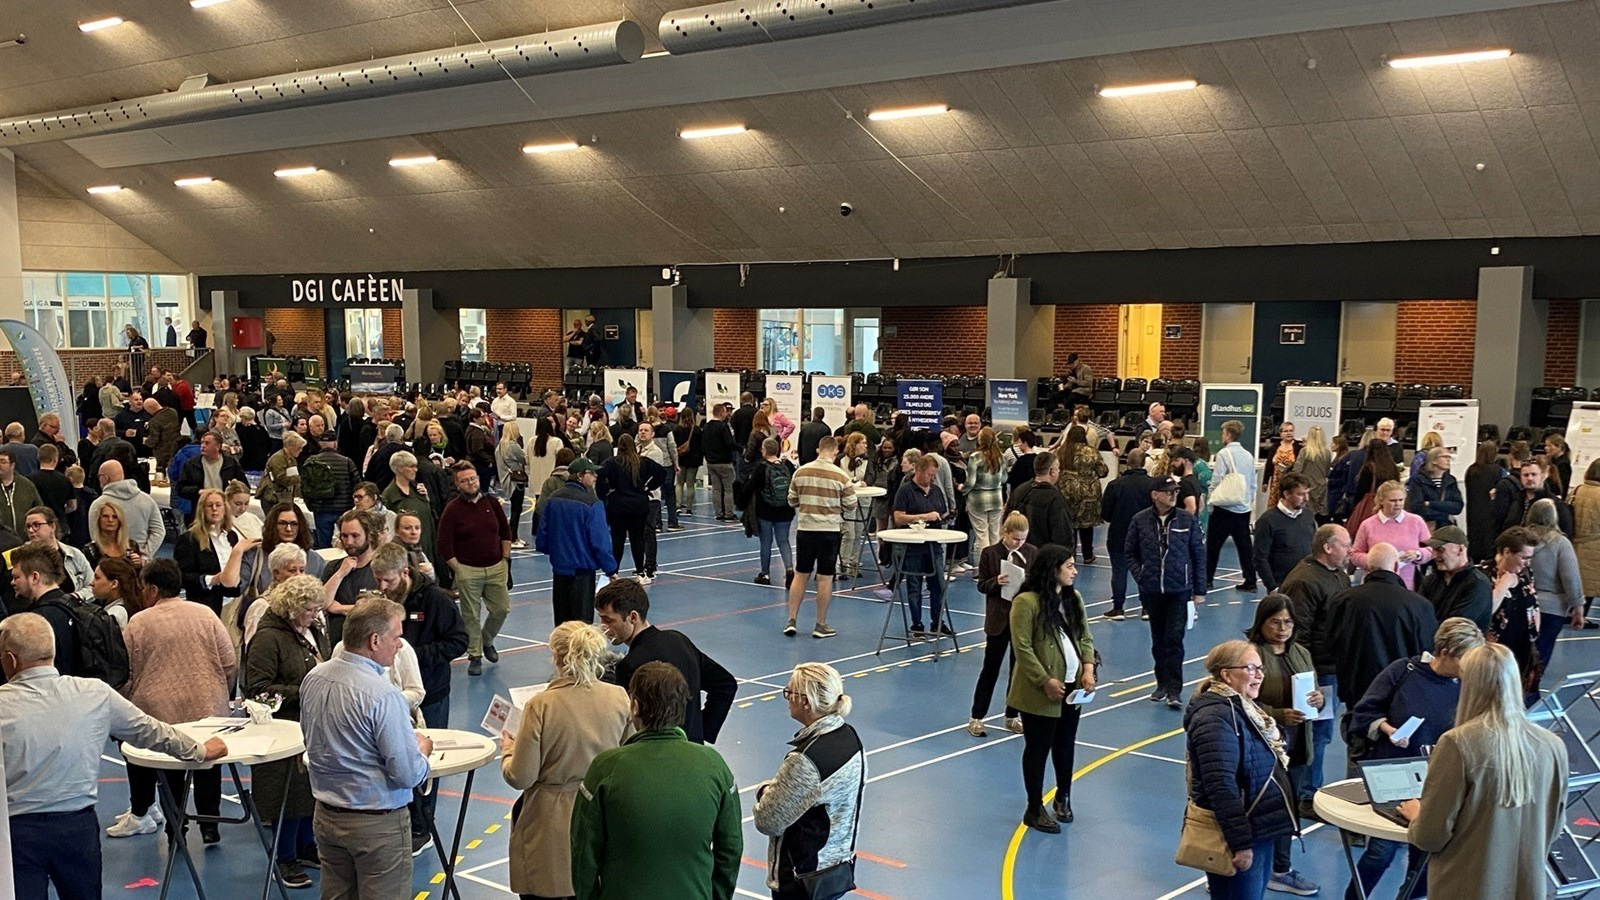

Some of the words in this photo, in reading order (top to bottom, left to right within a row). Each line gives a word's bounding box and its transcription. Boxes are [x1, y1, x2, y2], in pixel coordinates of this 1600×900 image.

[292, 279, 324, 302] DGI
[331, 273, 404, 302] CAFÈEN
[819, 386, 844, 398] JKS
[1306, 406, 1332, 418] DUOS
